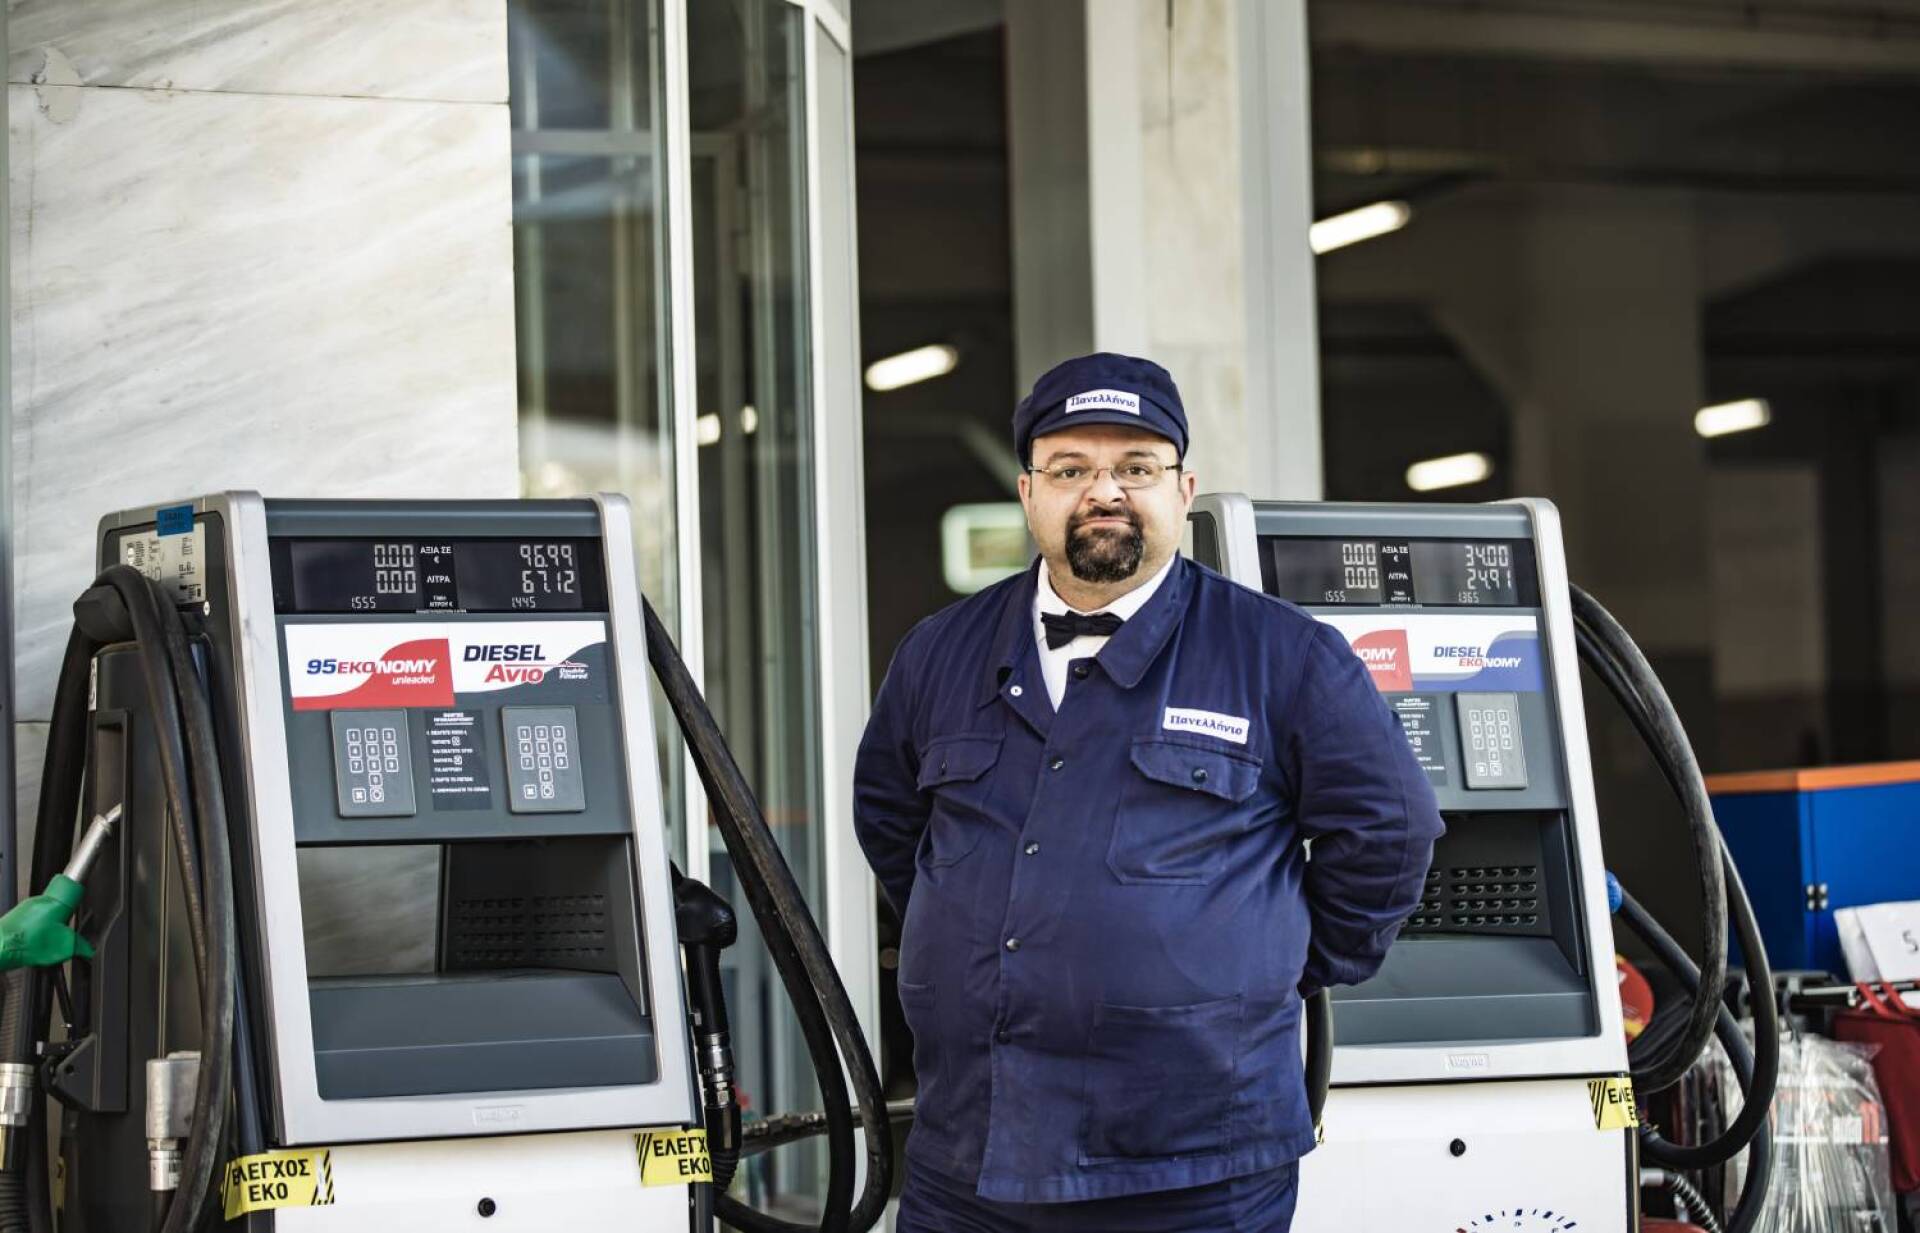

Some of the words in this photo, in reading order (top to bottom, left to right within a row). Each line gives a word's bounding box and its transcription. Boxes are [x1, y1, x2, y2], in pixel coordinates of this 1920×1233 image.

[420, 546, 440, 554] ΑΞΙΑ
[441, 546, 452, 554] ΣΕ
[1382, 546, 1398, 554] ΑΞΙΑ
[1399, 546, 1408, 554] ΣΕ
[427, 575, 451, 583] ΛΙΤΡΑ
[1388, 572, 1408, 580] ΛΙΤΡΑ
[463, 644, 546, 662] DIESEL
[1433, 646, 1484, 658] DIESEL
[1457, 657, 1522, 668] EKONOMY
[392, 675, 436, 685] unleaded
[1169, 715, 1243, 736] Πανελλήνιο
[678, 1157, 710, 1176] ΕΚΟ
[248, 1182, 289, 1202] ΕΚΟ
